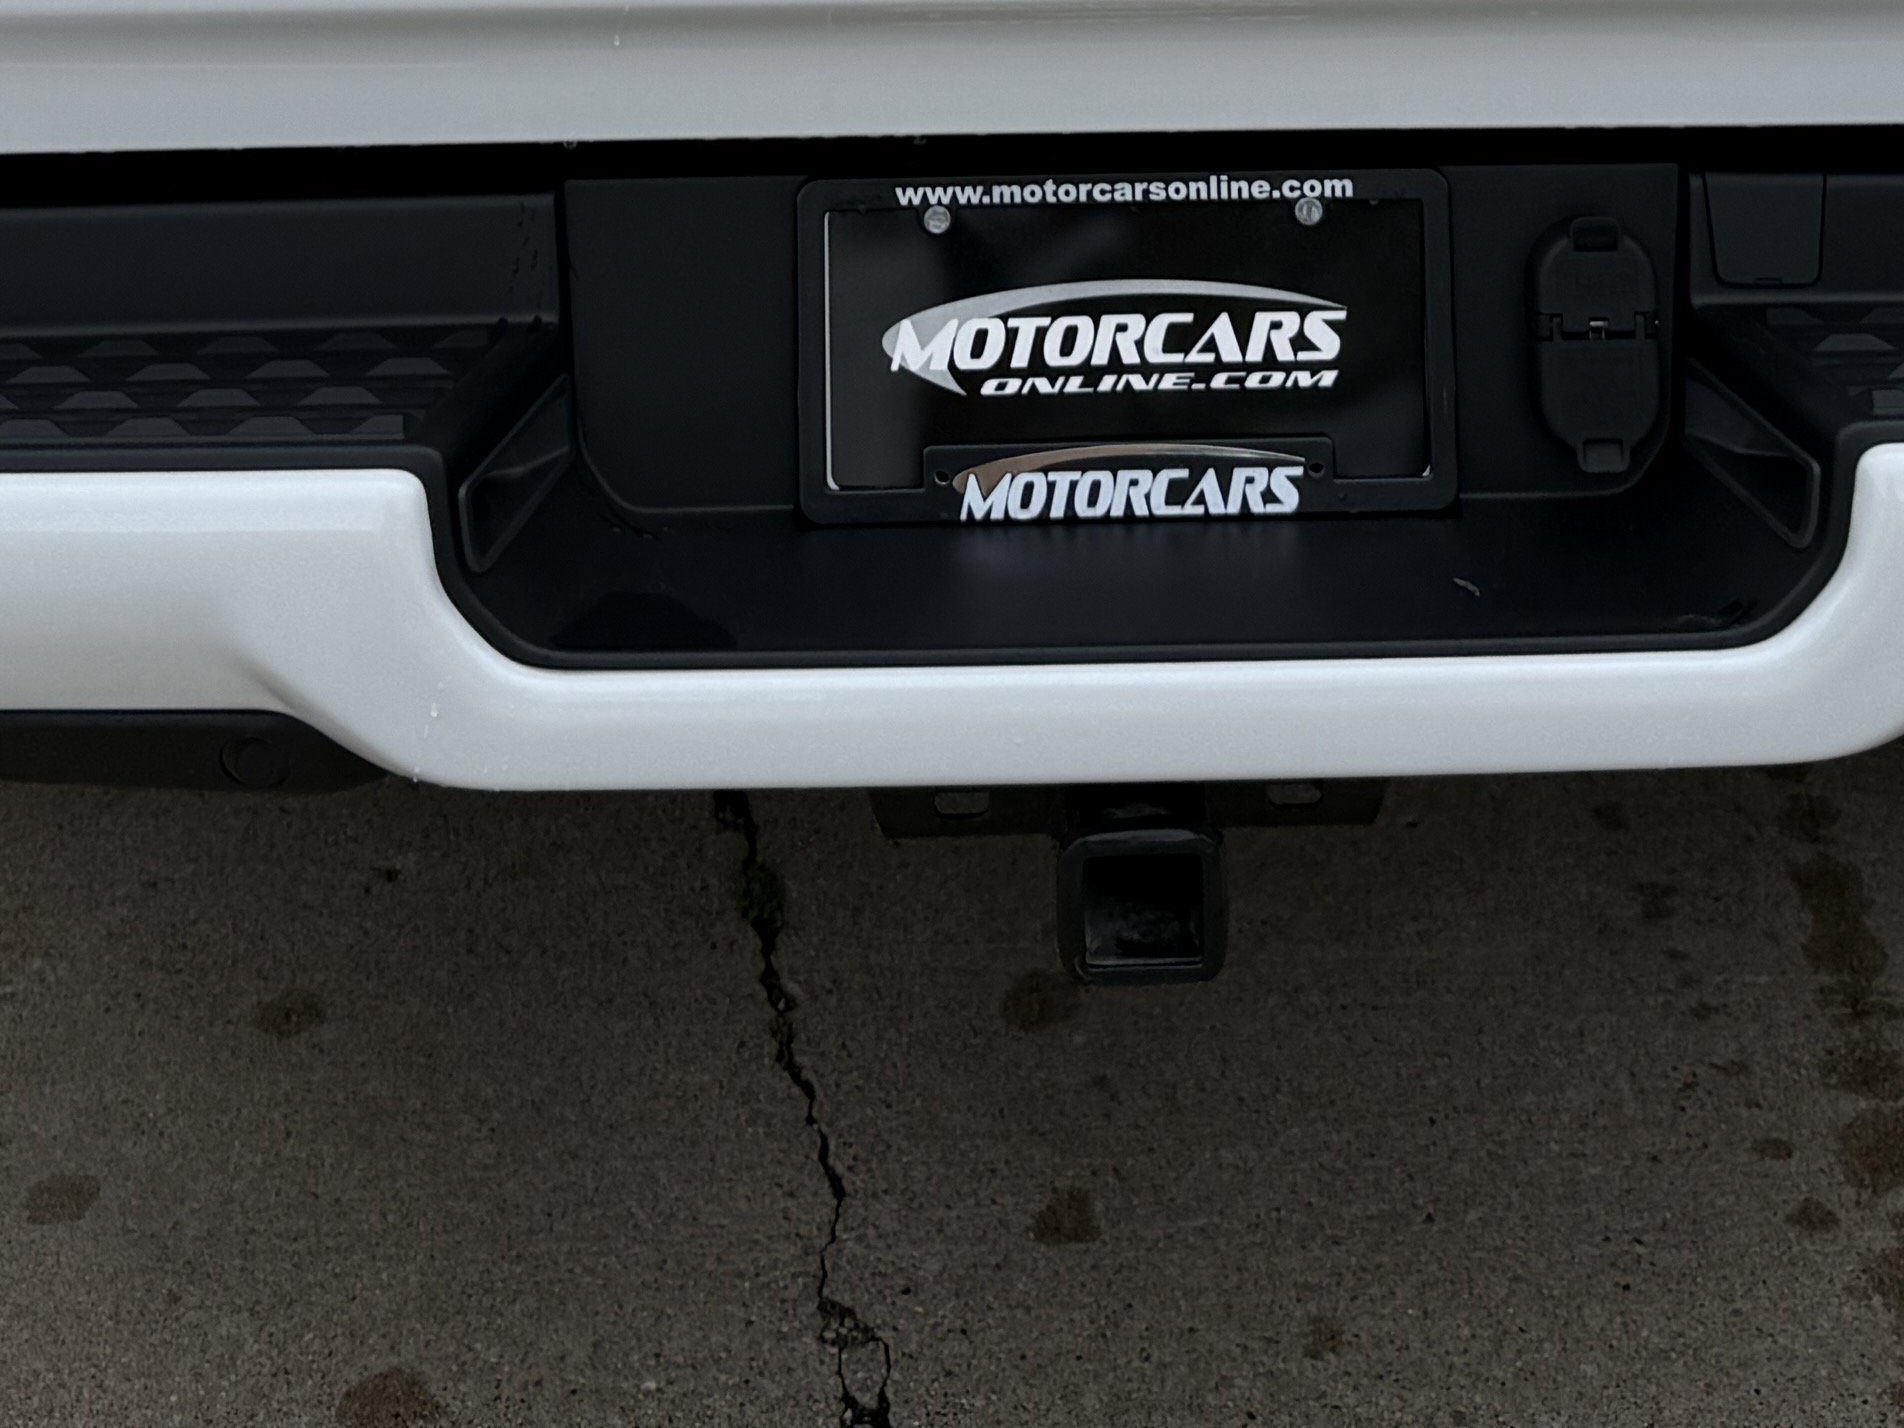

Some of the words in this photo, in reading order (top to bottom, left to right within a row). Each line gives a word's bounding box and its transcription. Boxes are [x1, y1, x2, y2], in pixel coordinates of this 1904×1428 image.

[895, 175, 1354, 206] www.motorcarsonline.com
[890, 309, 1348, 372] MOTORCARS
[979, 369, 1340, 397] ONLINE.COM
[960, 465, 1305, 522] MOTORCARS
